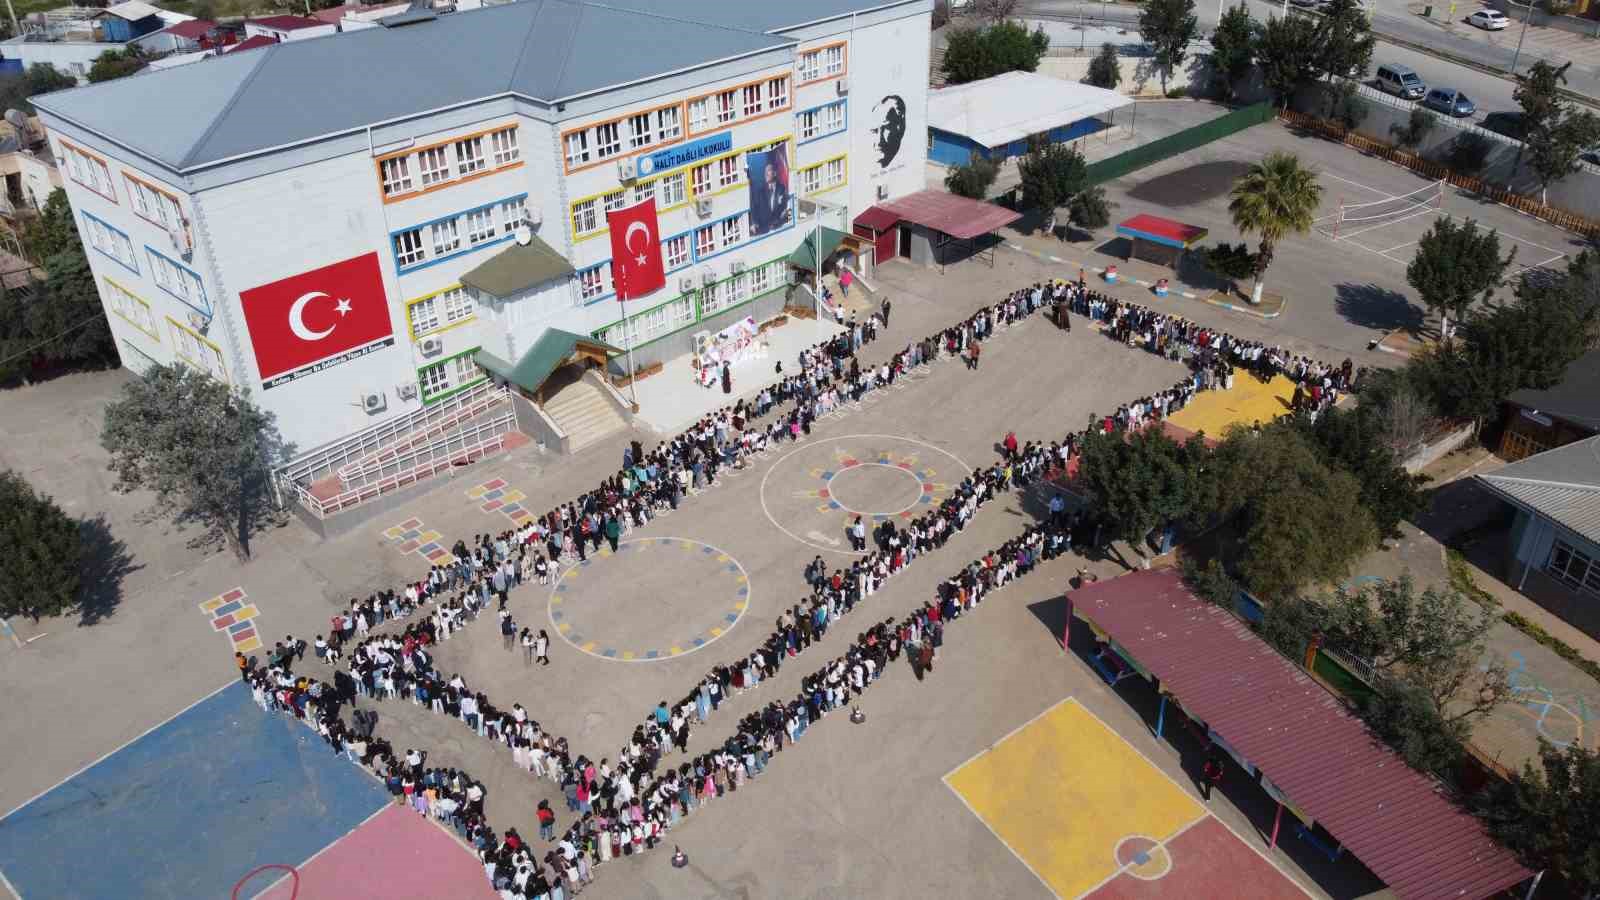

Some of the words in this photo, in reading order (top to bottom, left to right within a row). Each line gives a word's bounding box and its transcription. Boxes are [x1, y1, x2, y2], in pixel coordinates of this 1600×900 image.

[654, 156, 675, 169] HALİT
[676, 149, 697, 164] DAĞLI
[697, 140, 730, 157] İLKOKULU
